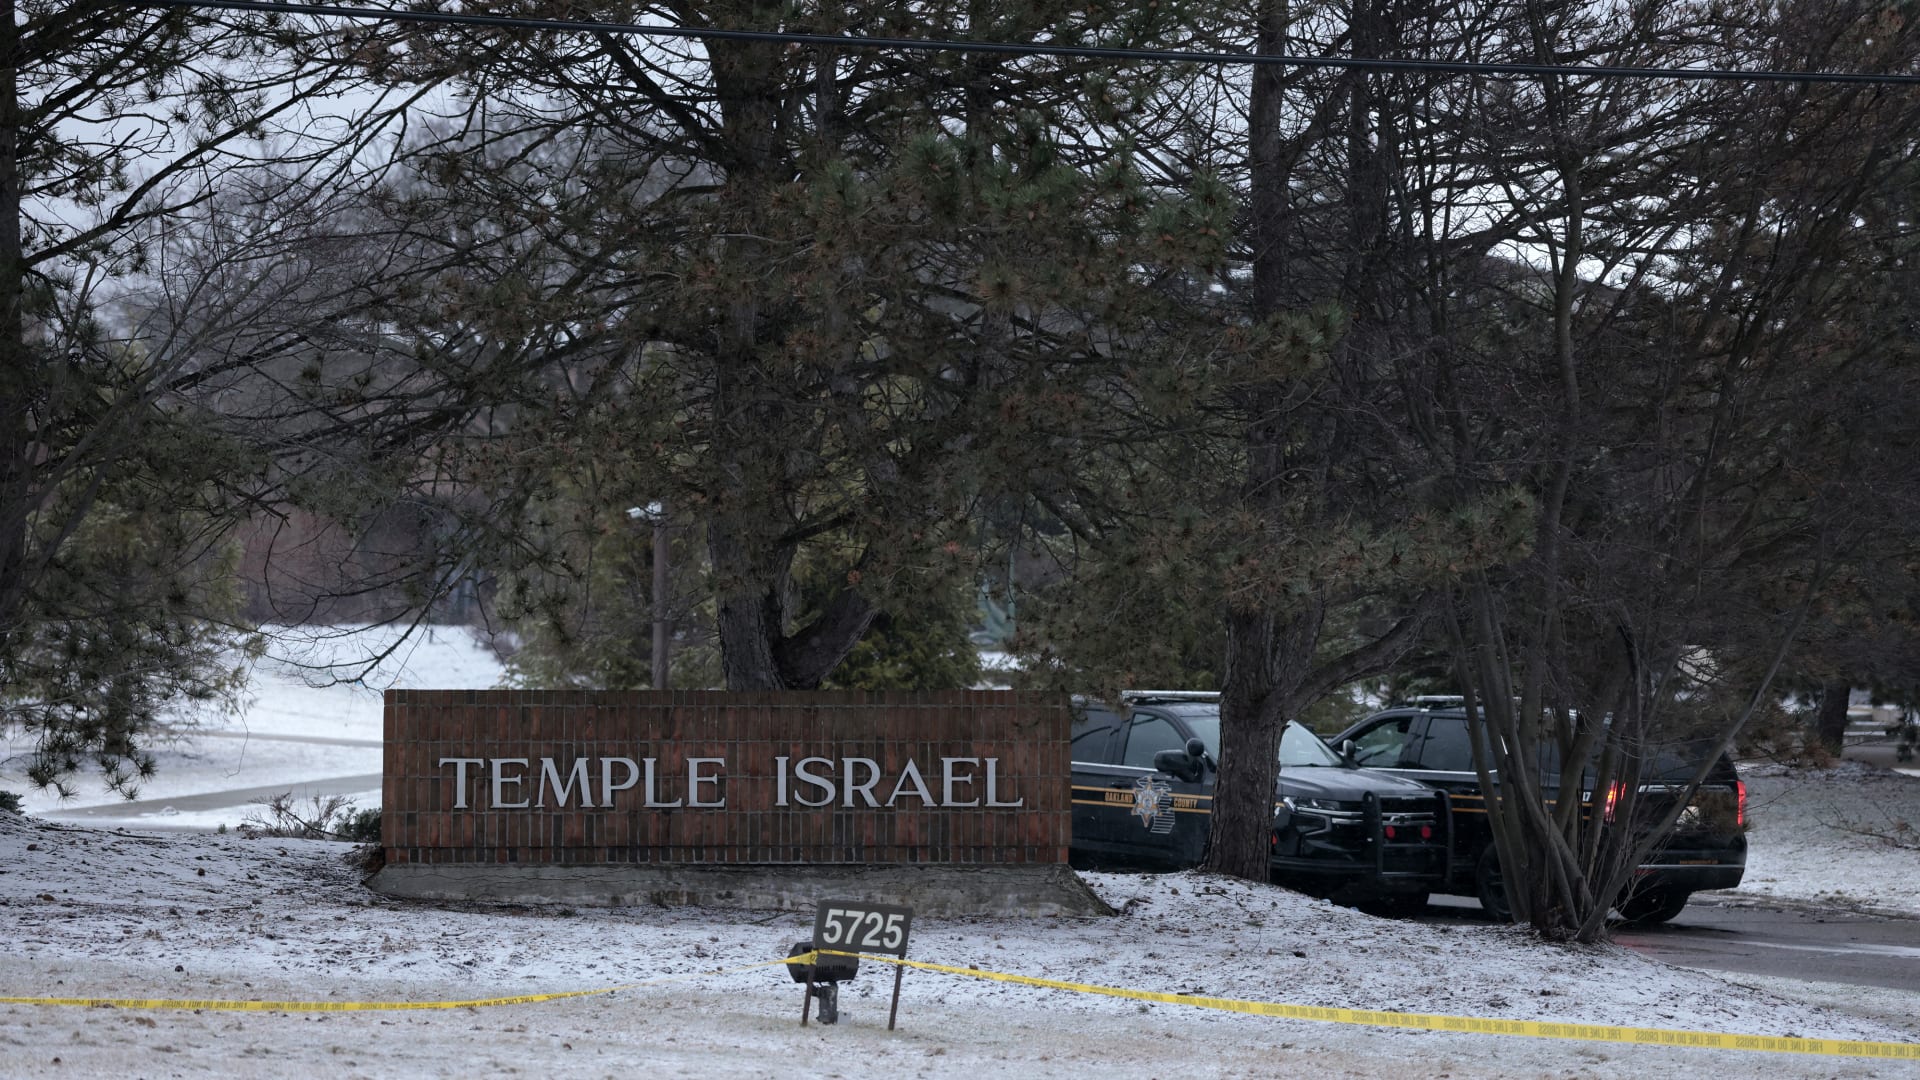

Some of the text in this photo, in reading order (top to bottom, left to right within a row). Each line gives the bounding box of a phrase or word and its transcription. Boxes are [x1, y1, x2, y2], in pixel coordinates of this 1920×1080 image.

[438, 755, 1024, 809] TEMPLE ISRAEL
[1173, 797, 1198, 808] COUNTY
[822, 908, 905, 949] 5725
